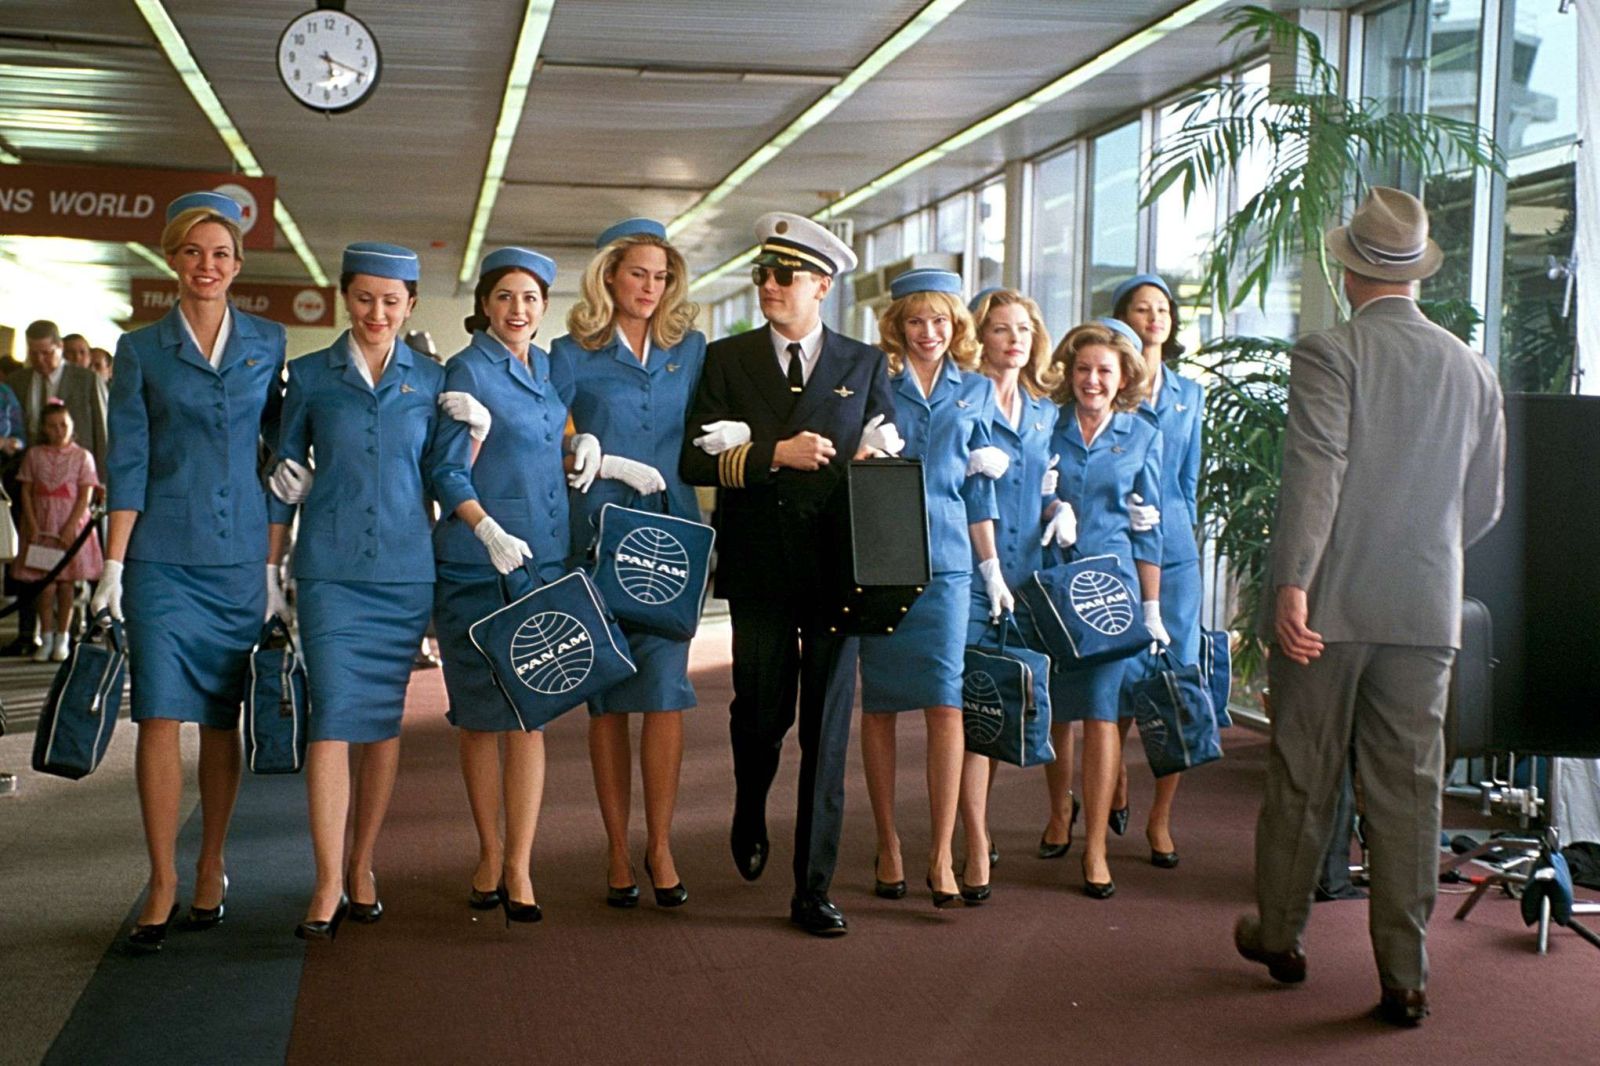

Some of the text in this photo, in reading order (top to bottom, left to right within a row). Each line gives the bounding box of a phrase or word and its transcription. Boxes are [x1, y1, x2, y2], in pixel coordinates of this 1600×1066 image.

[307, 22, 317, 33] 11
[324, 19, 335, 30] 12
[344, 25, 350, 36] 1
[294, 34, 305, 45] 10
[356, 38, 363, 50] 2
[361, 56, 368, 68] 3
[307, 82, 313, 95] 7
[341, 86, 348, 97] 5
[50, 190, 155, 218] WORLD
[616, 553, 688, 578] PAN AM
[1074, 592, 1128, 612] PAN AM
[516, 631, 588, 676] PAN AM
[980, 705, 1002, 716] AM
